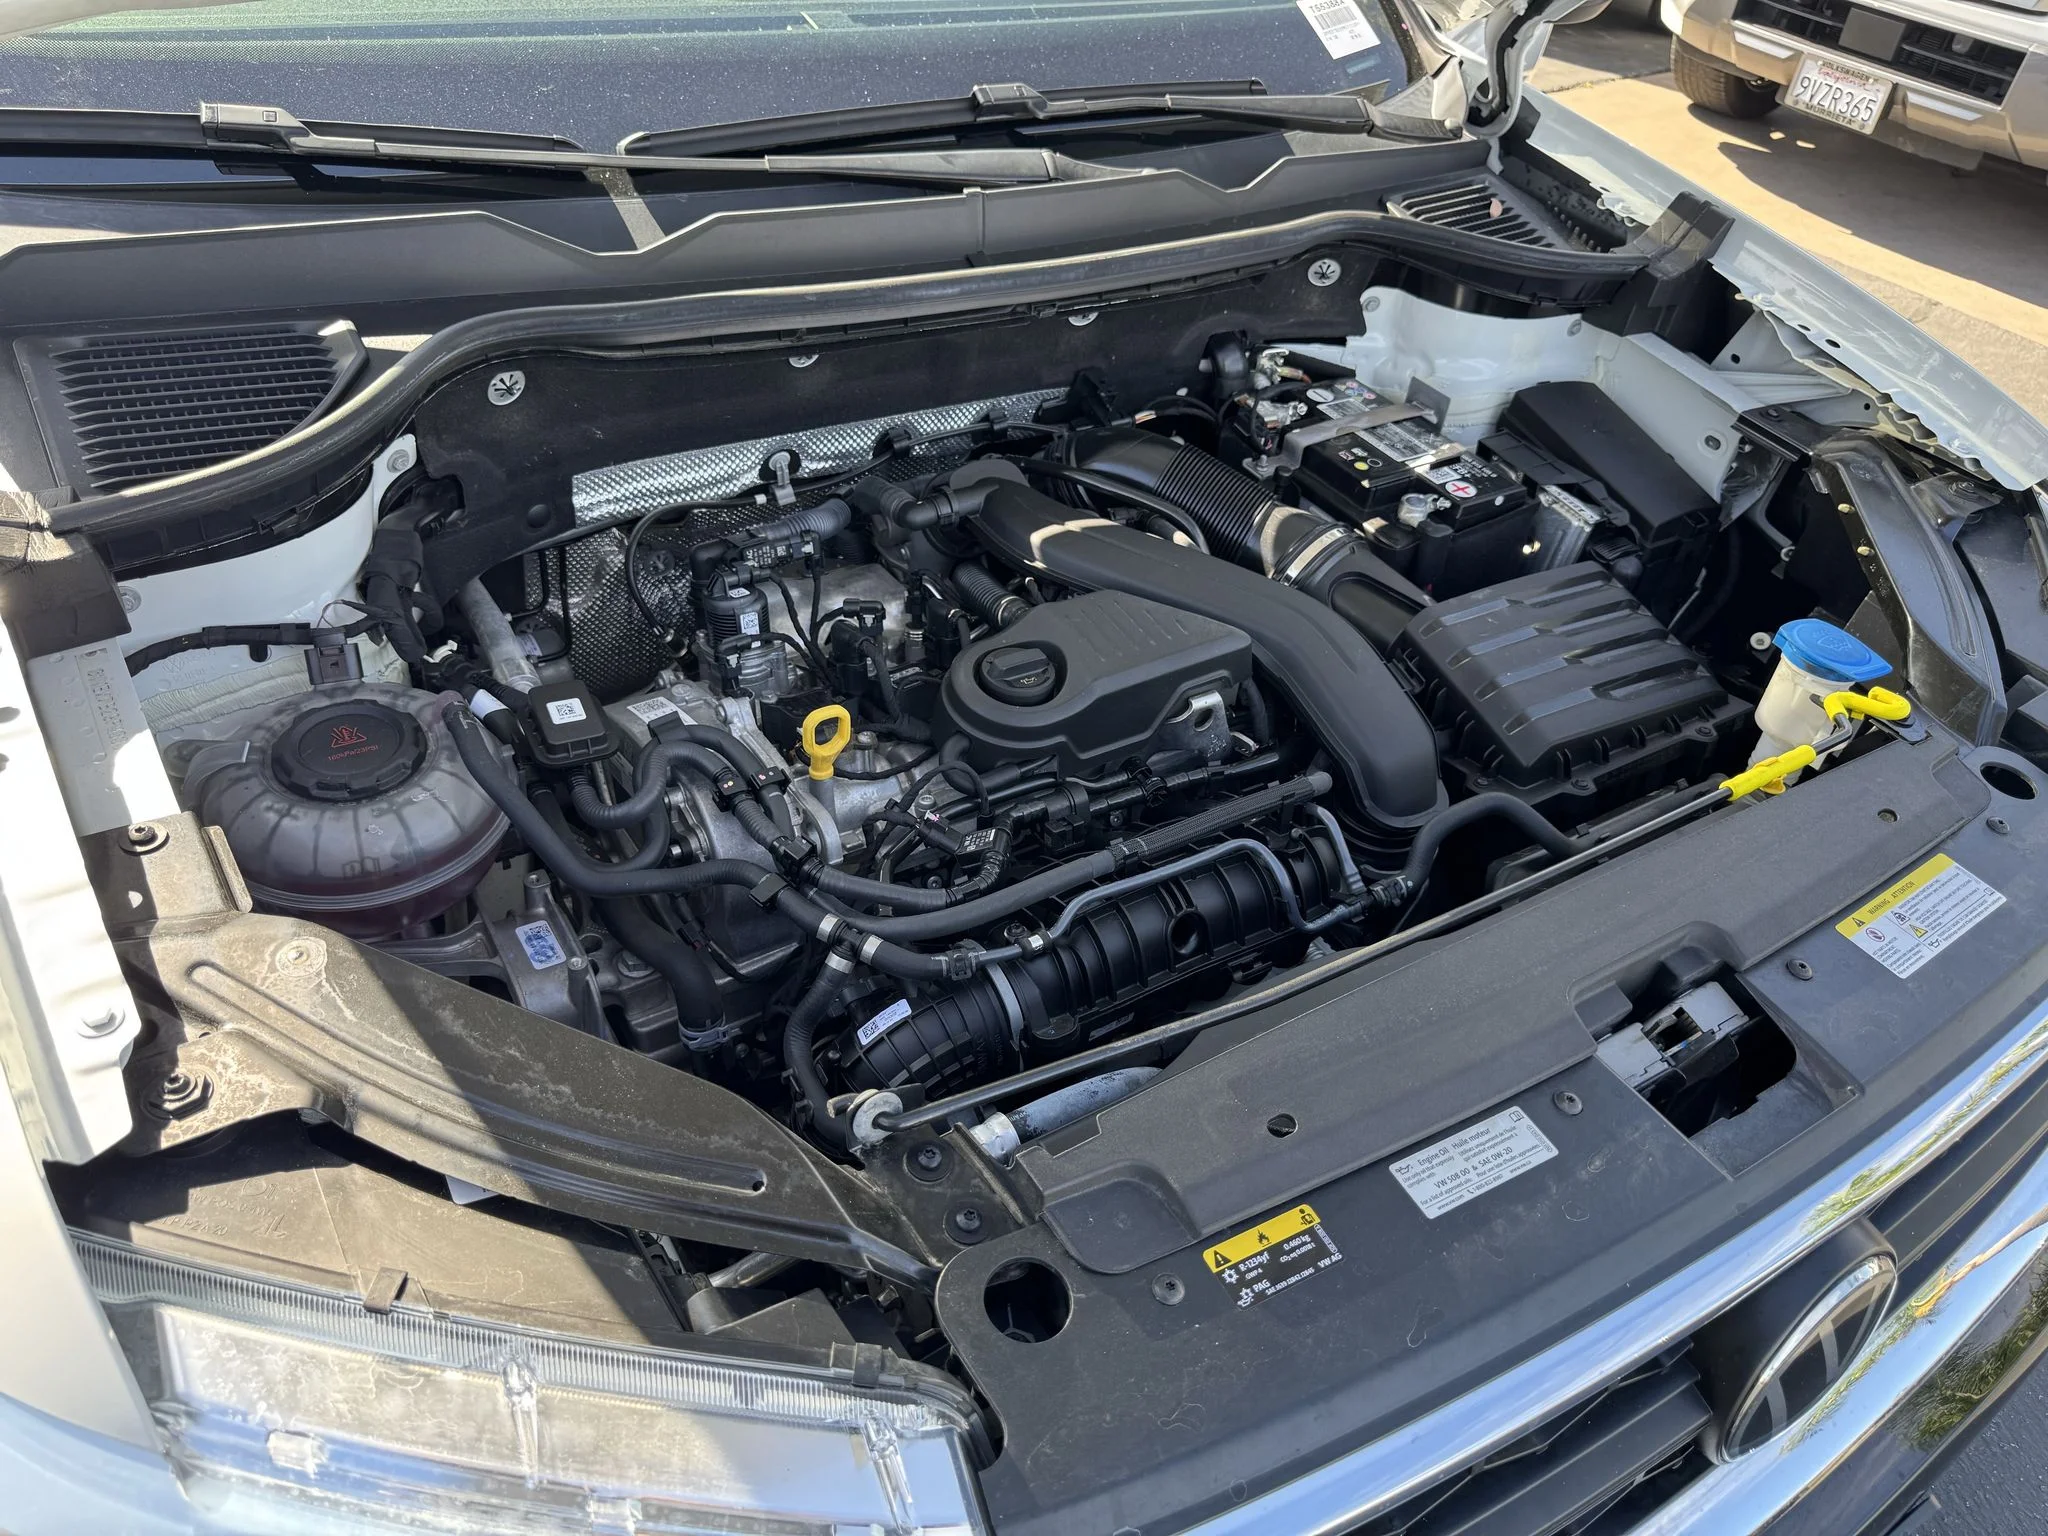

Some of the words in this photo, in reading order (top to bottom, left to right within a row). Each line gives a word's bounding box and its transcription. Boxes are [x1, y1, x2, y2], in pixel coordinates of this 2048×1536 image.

[1795, 76, 1877, 122] 9VZR365
[1866, 898, 1891, 916] WARNING
[1890, 880, 1916, 899] ATTENTION
[1418, 1153, 1440, 1166] Engine
[1438, 1147, 1449, 1156] Oil
[1451, 1139, 1469, 1149] Huile
[1469, 1128, 1490, 1141] moteur
[1434, 1179, 1447, 1188] VW
[1447, 1172, 1460, 1183] 508
[1460, 1168, 1470, 1176] 00
[1478, 1157, 1492, 1167] SAE
[1491, 1147, 1512, 1160] 0W-20
[1283, 1238, 1301, 1250] 0.460
[1239, 1252, 1269, 1271] R-1234yf
[1318, 1258, 1331, 1267] VW
[1331, 1253, 1342, 1262] AG
[1245, 1270, 1257, 1279] GWP
[1253, 1280, 1270, 1292] PAG
